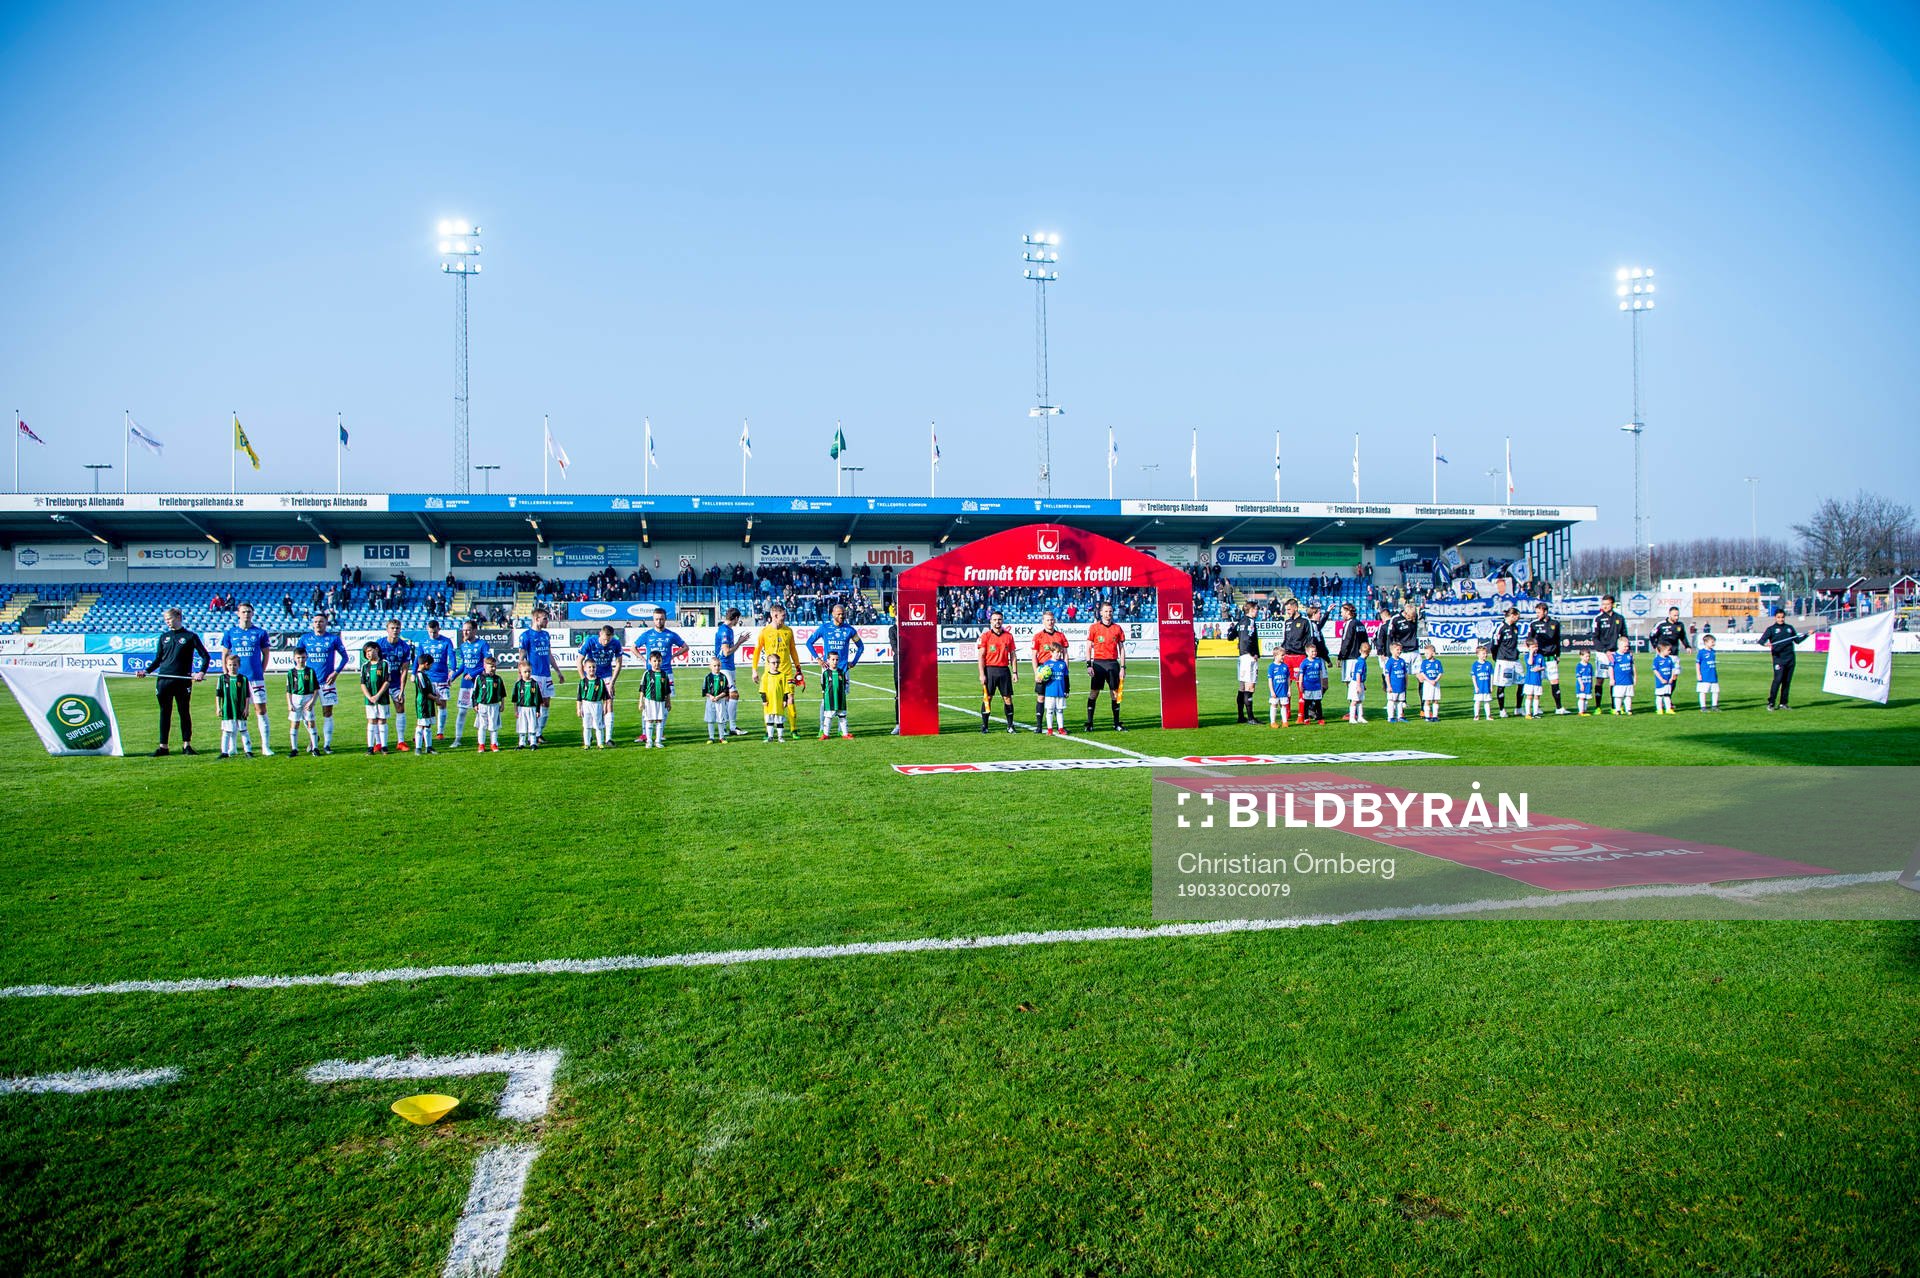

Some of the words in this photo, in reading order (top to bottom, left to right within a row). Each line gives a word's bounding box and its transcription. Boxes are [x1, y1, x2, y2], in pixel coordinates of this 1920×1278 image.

[45, 497, 87, 508] Trelleborgs
[88, 497, 125, 507] Allehanda
[159, 497, 244, 508] trelleborgsallehanda.se
[291, 498, 333, 508] Trelleborgs
[333, 498, 368, 507] Allehanda
[1147, 503, 1180, 512] Trelleborgs
[1181, 504, 1209, 512] Allehanda
[1235, 505, 1300, 514] trelleborgsallehanda.se
[1334, 505, 1364, 514] Trelleborgs
[1365, 506, 1391, 514] Allehanda
[152, 547, 209, 561] stoby
[248, 545, 310, 561] ELON
[474, 547, 531, 557] exakta
[761, 545, 798, 555] SAWI
[867, 545, 914, 564] umia
[964, 565, 1014, 581] Framåt
[1015, 565, 1035, 581] för
[1038, 566, 1081, 581] svensk
[1083, 566, 1132, 581] fotboll!
[1430, 623, 1474, 637] TRUE
[1833, 670, 1869, 682] SVENSKA
[1869, 676, 1885, 686] SPEL
[65, 719, 106, 741] SUPERETTAN
[1501, 853, 1634, 865] SVENSKA
